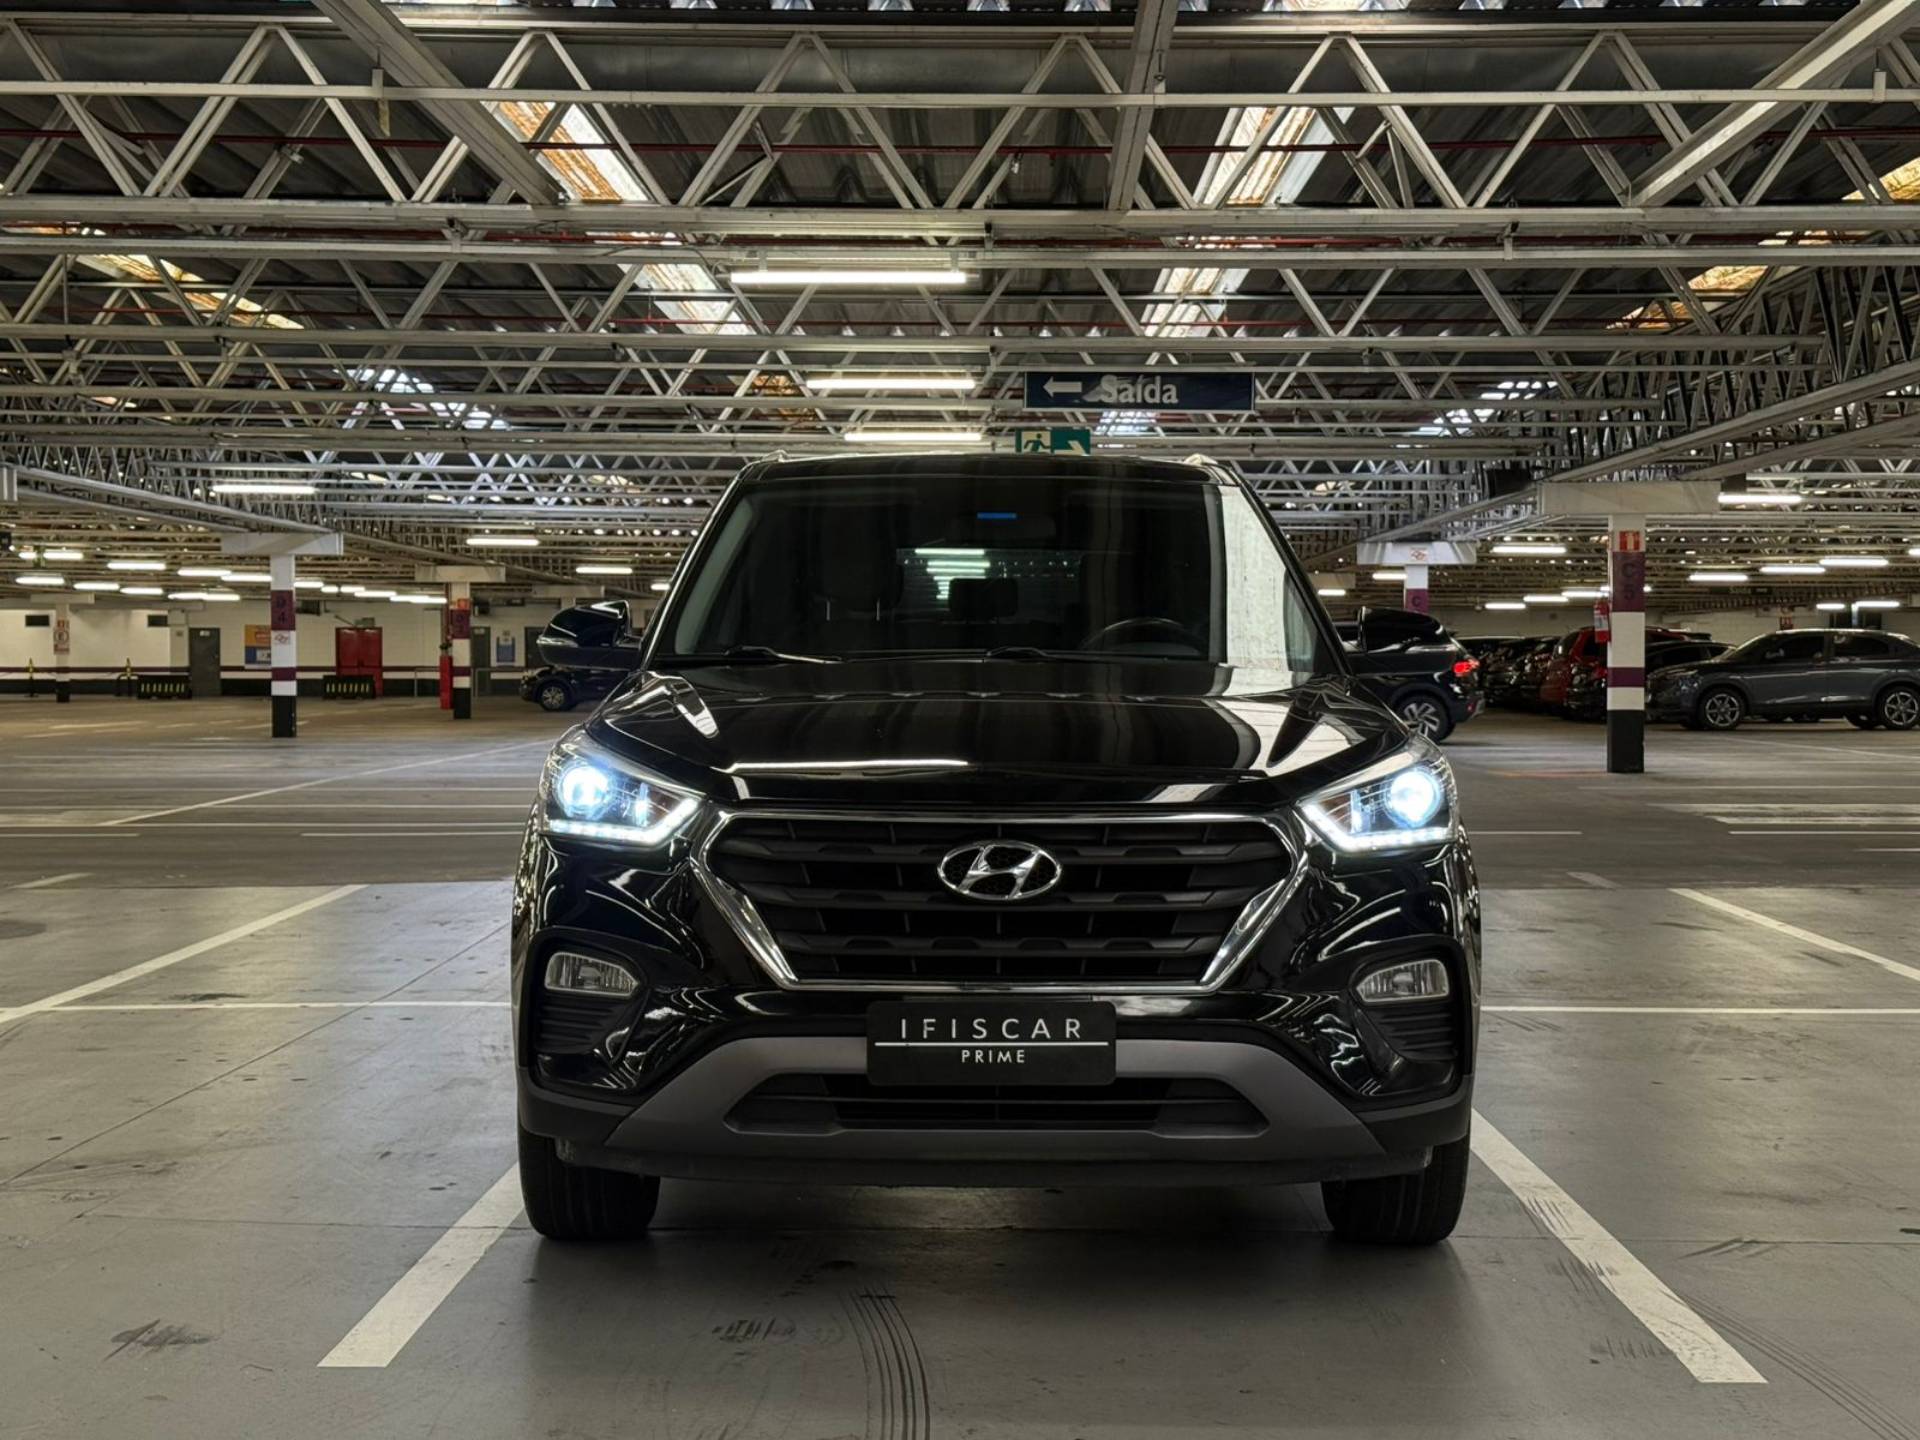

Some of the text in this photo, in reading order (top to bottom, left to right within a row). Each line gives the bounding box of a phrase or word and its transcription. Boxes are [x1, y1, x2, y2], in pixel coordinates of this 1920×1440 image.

[1099, 374, 1178, 404] Saída
[901, 1018, 1081, 1039] IFISCAR
[961, 1049, 1025, 1064] PRIME
